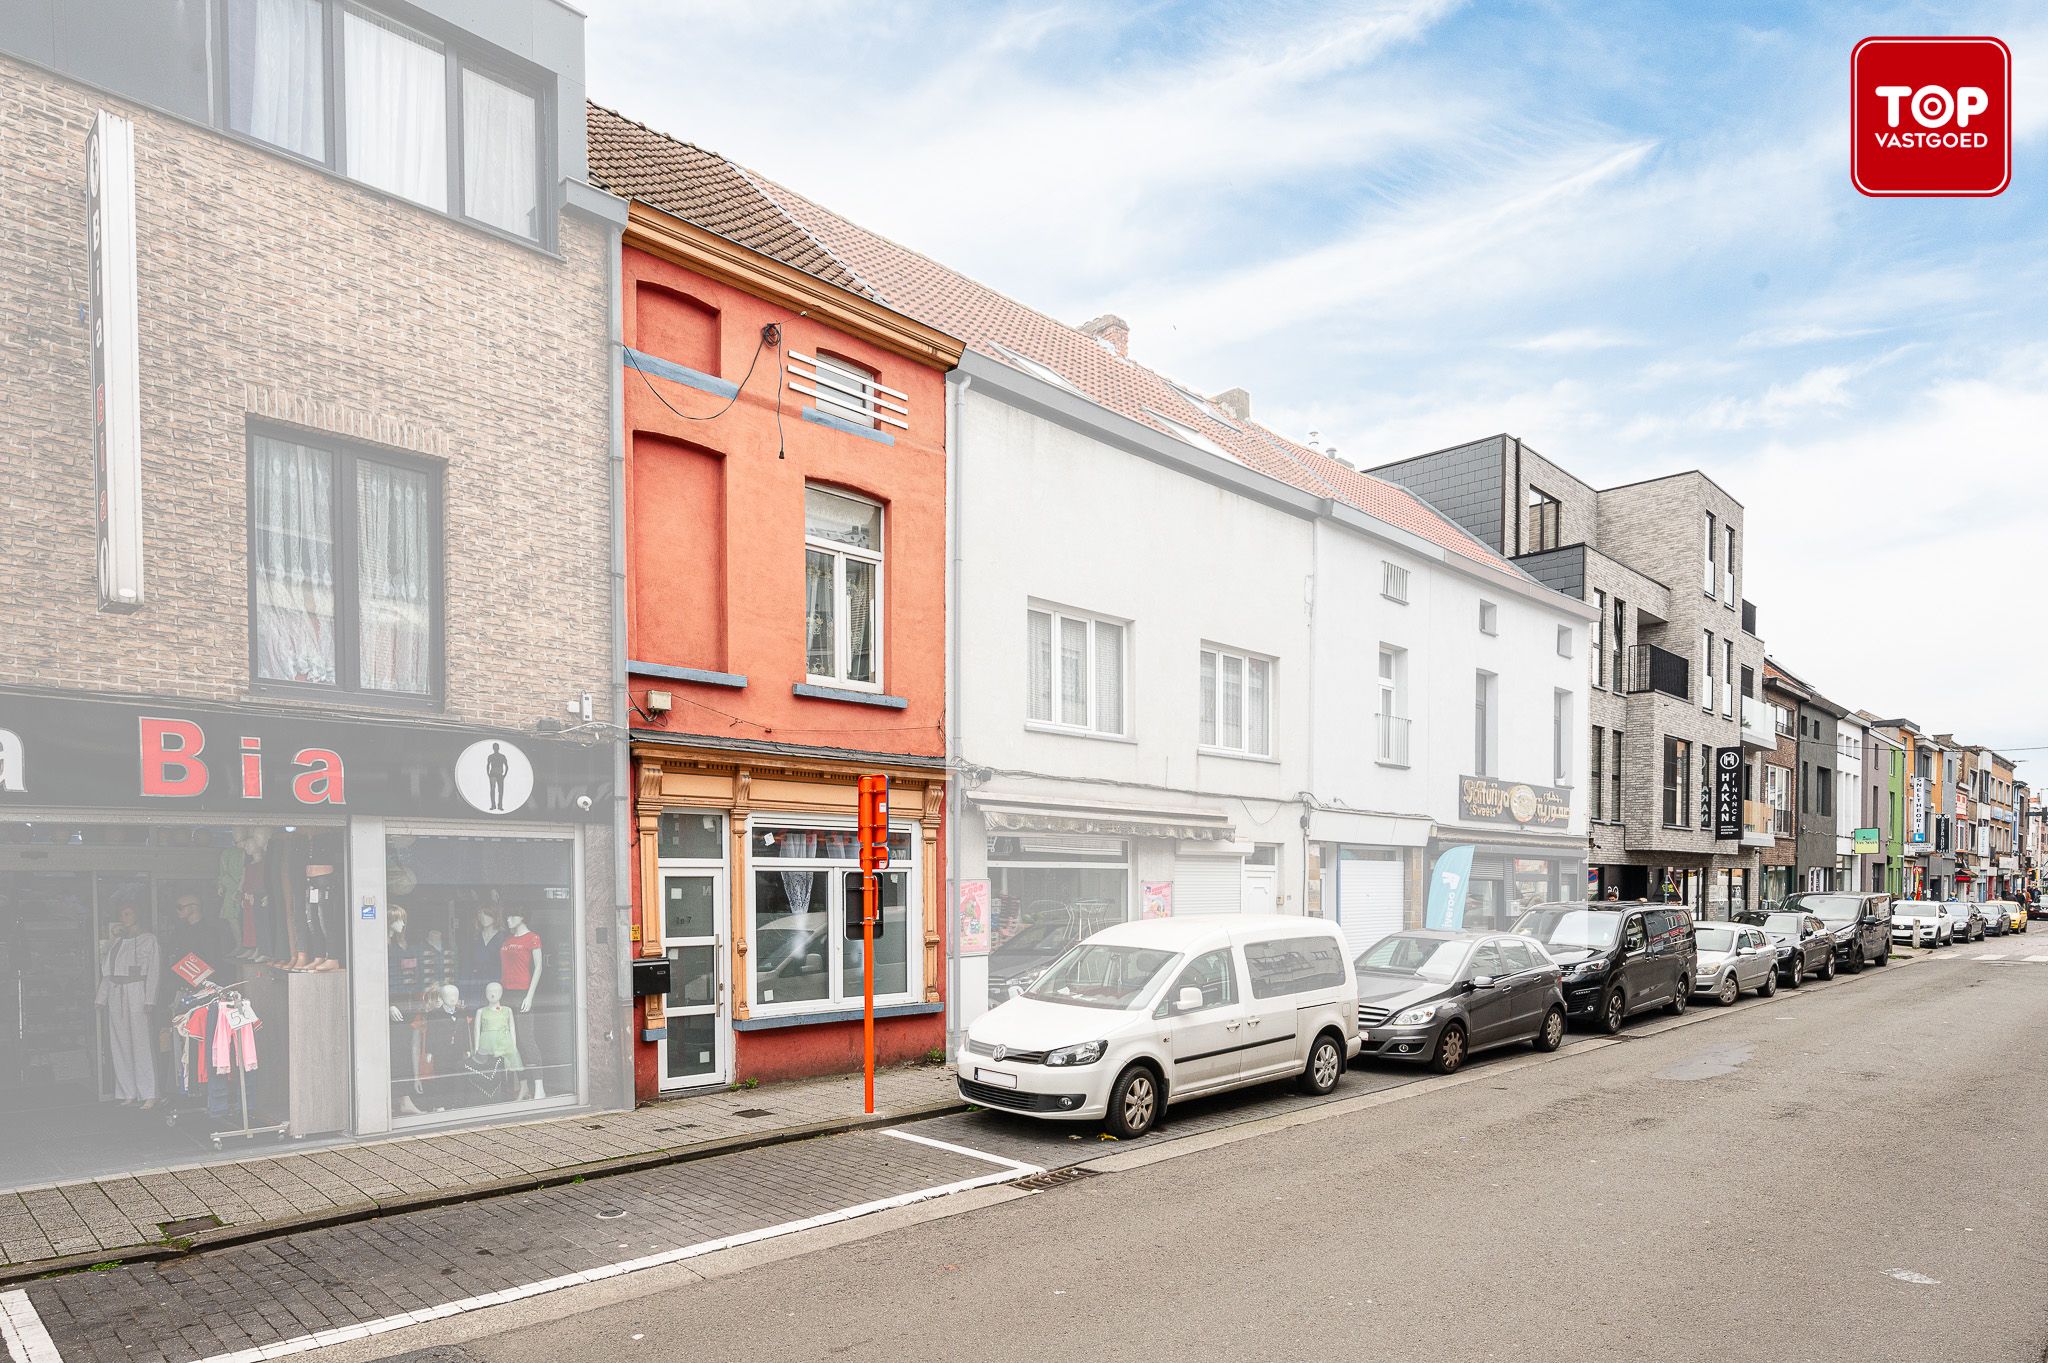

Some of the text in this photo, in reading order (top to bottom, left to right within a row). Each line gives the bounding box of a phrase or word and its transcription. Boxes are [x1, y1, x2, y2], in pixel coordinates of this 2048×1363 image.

[138, 716, 347, 805] Bia
[1721, 772, 1730, 822] HAKAN
[1442, 891, 1456, 928] iveroo
